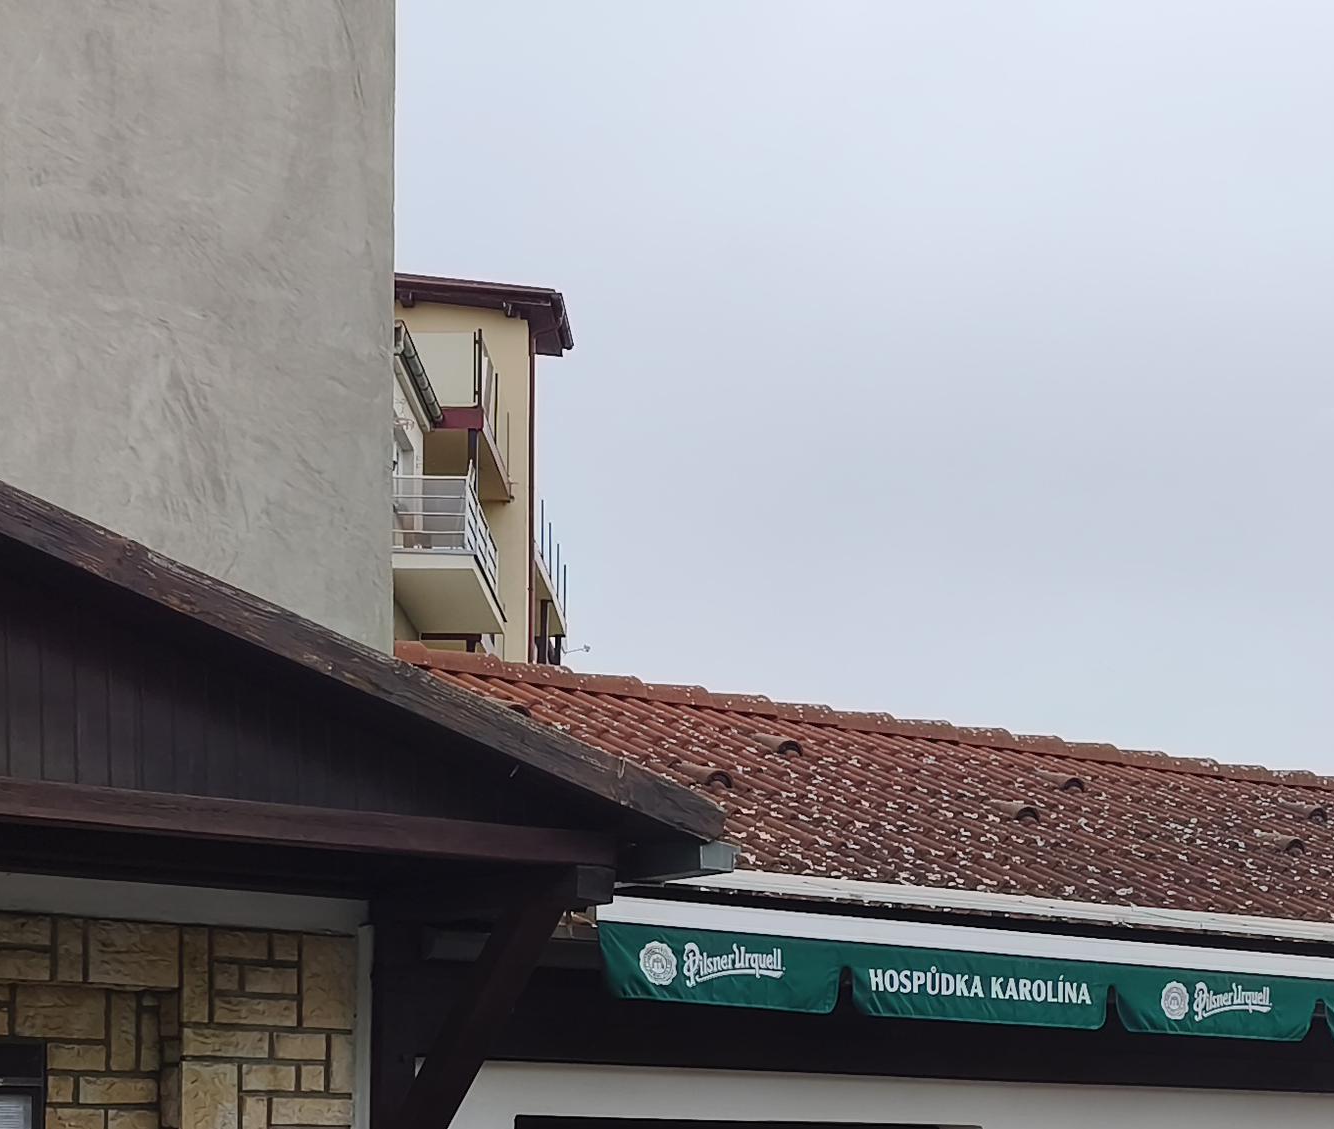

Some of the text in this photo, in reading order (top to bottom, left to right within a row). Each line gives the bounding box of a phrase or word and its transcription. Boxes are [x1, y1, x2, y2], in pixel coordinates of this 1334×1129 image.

[683, 942, 734, 987] Pilsner
[732, 943, 782, 978] Urquell
[868, 966, 1092, 1005] HOSPŮDKA KAROLÍNA
[1193, 981, 1270, 1022] Pilsner Urquell
